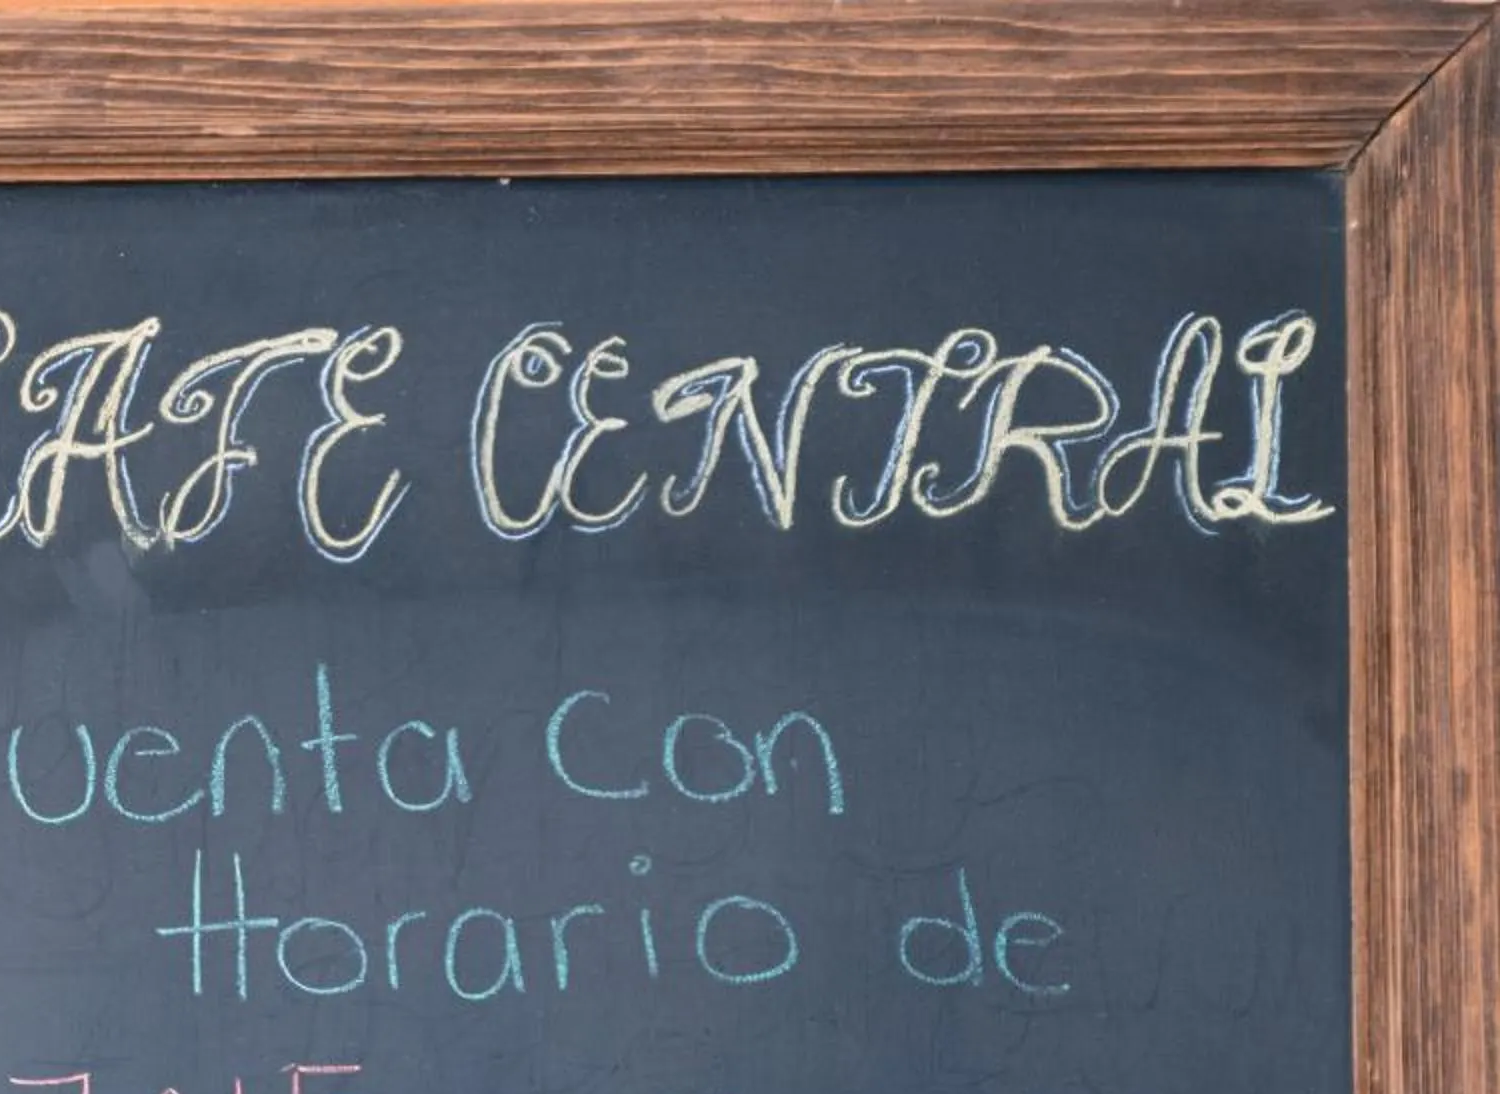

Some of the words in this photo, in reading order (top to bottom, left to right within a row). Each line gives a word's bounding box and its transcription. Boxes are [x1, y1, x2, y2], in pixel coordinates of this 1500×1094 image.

[469, 310, 1334, 540] CENTRAL
[156, 848, 799, 1001] Horario
[900, 867, 1070, 999] de
